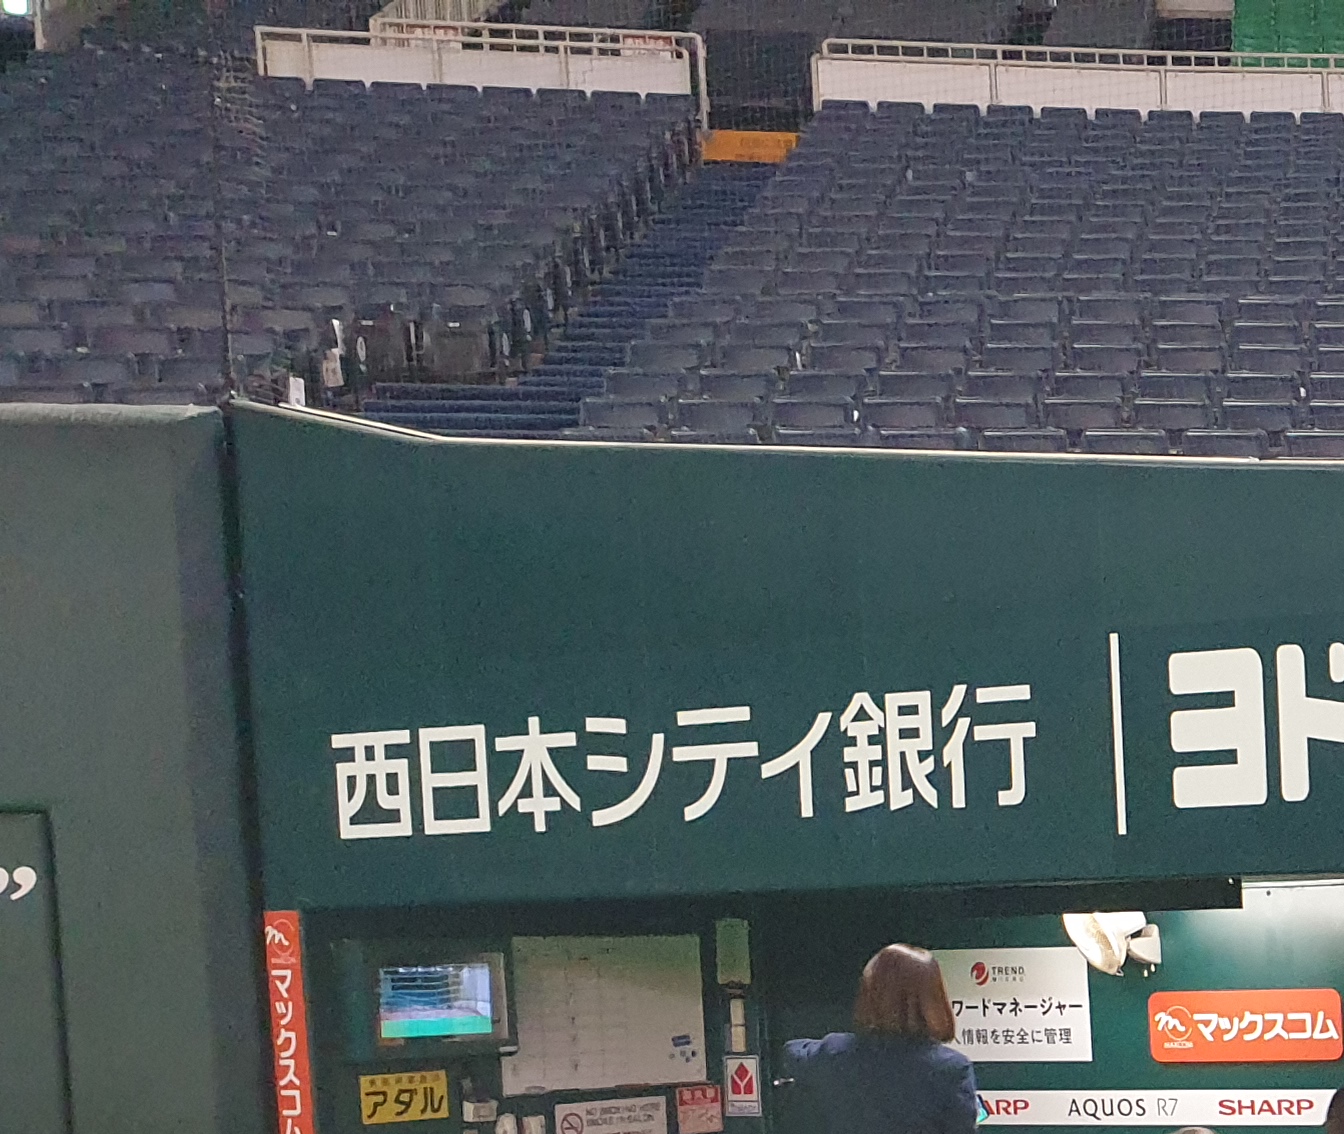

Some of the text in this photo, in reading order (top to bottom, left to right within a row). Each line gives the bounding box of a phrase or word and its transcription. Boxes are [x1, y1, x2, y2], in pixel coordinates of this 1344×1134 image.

[331, 684, 1037, 839] 西日本シティ銀行
[991, 966, 1025, 975] TREND
[952, 997, 1084, 1017] ワードマネージャー
[1193, 1011, 1339, 1042] マックスコム
[365, 1087, 444, 1119] アダル
[1068, 1097, 1146, 1120] AQUOS
[1157, 1097, 1179, 1117] R7
[1218, 1098, 1315, 1117] SHARP
